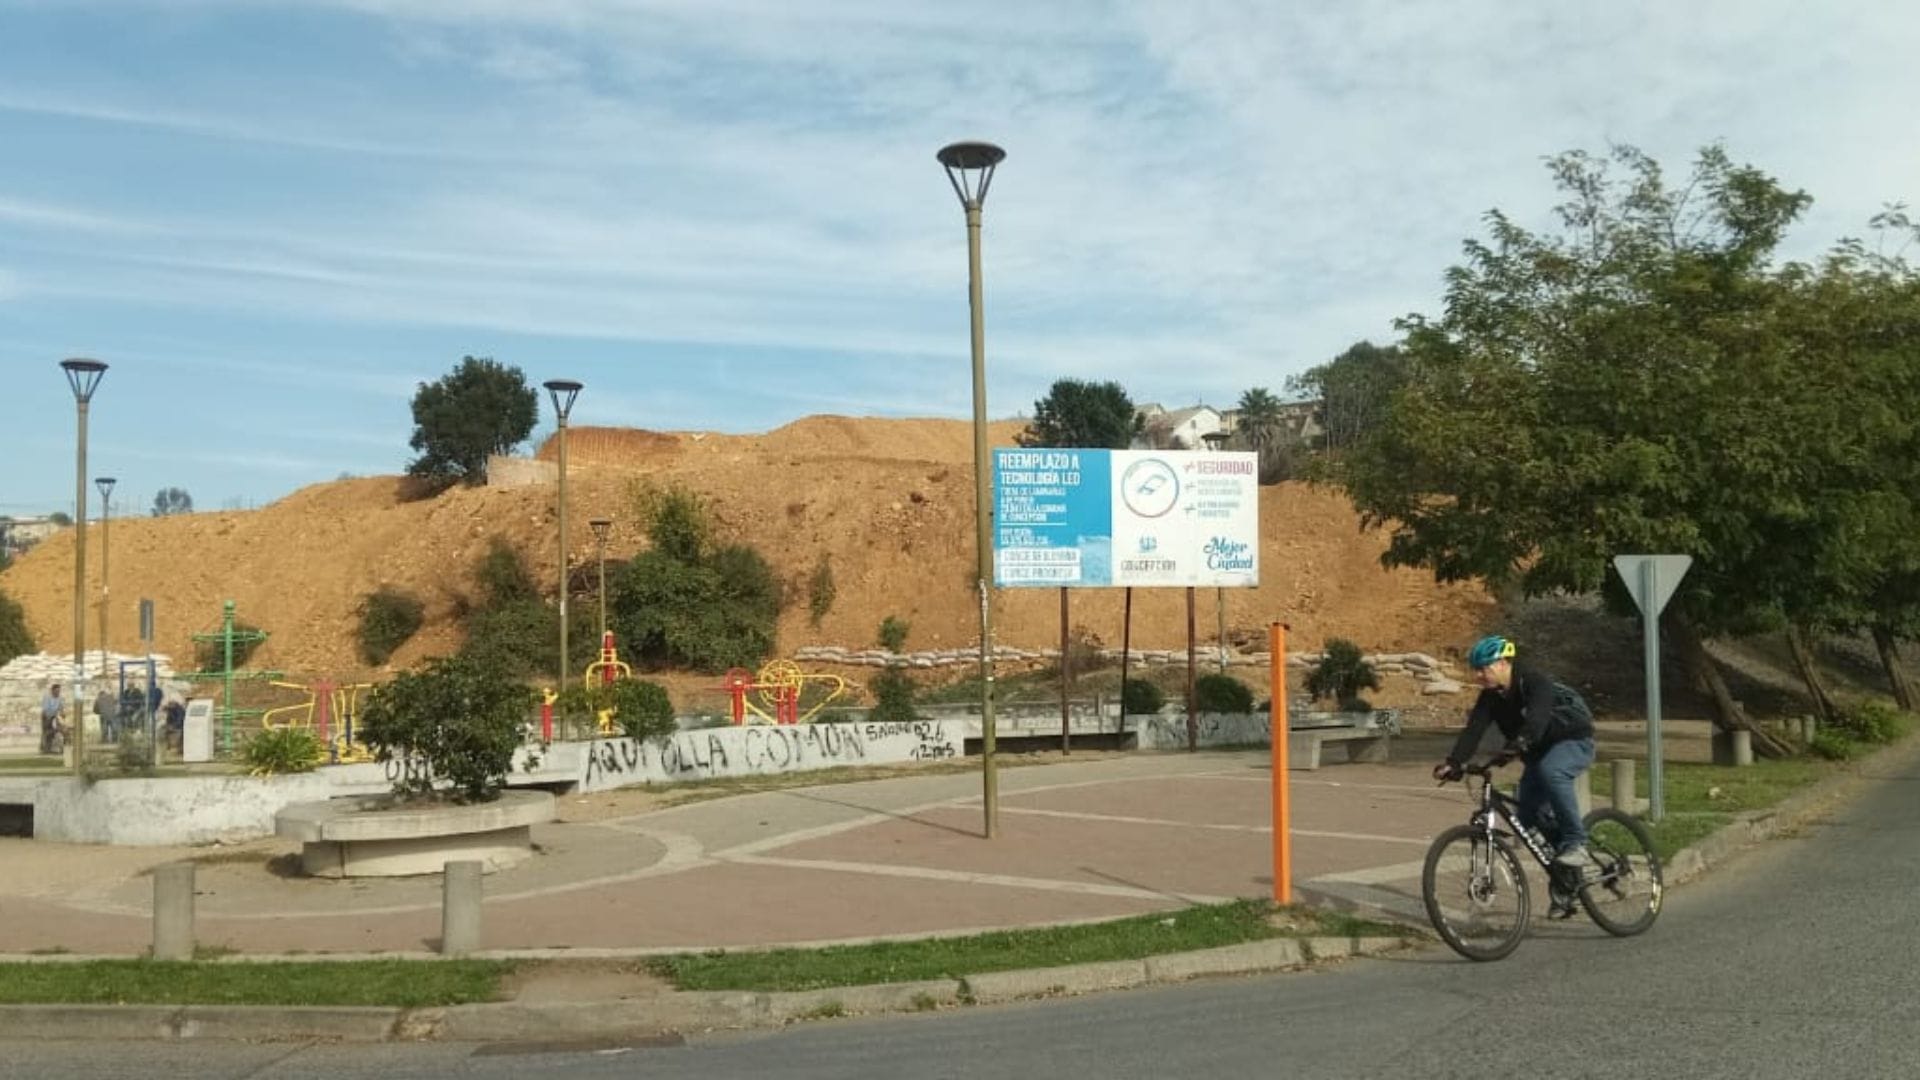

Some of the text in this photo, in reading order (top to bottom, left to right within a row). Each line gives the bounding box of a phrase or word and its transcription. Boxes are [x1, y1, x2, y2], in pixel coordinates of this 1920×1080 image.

[999, 453, 1080, 469] REEMPLAZO A
[1197, 461, 1253, 474] SEGURIDAD
[1062, 472, 1081, 485] LED
[1203, 536, 1248, 559] Mejor
[586, 739, 647, 785] AQUI
[661, 734, 728, 776] OLLA
